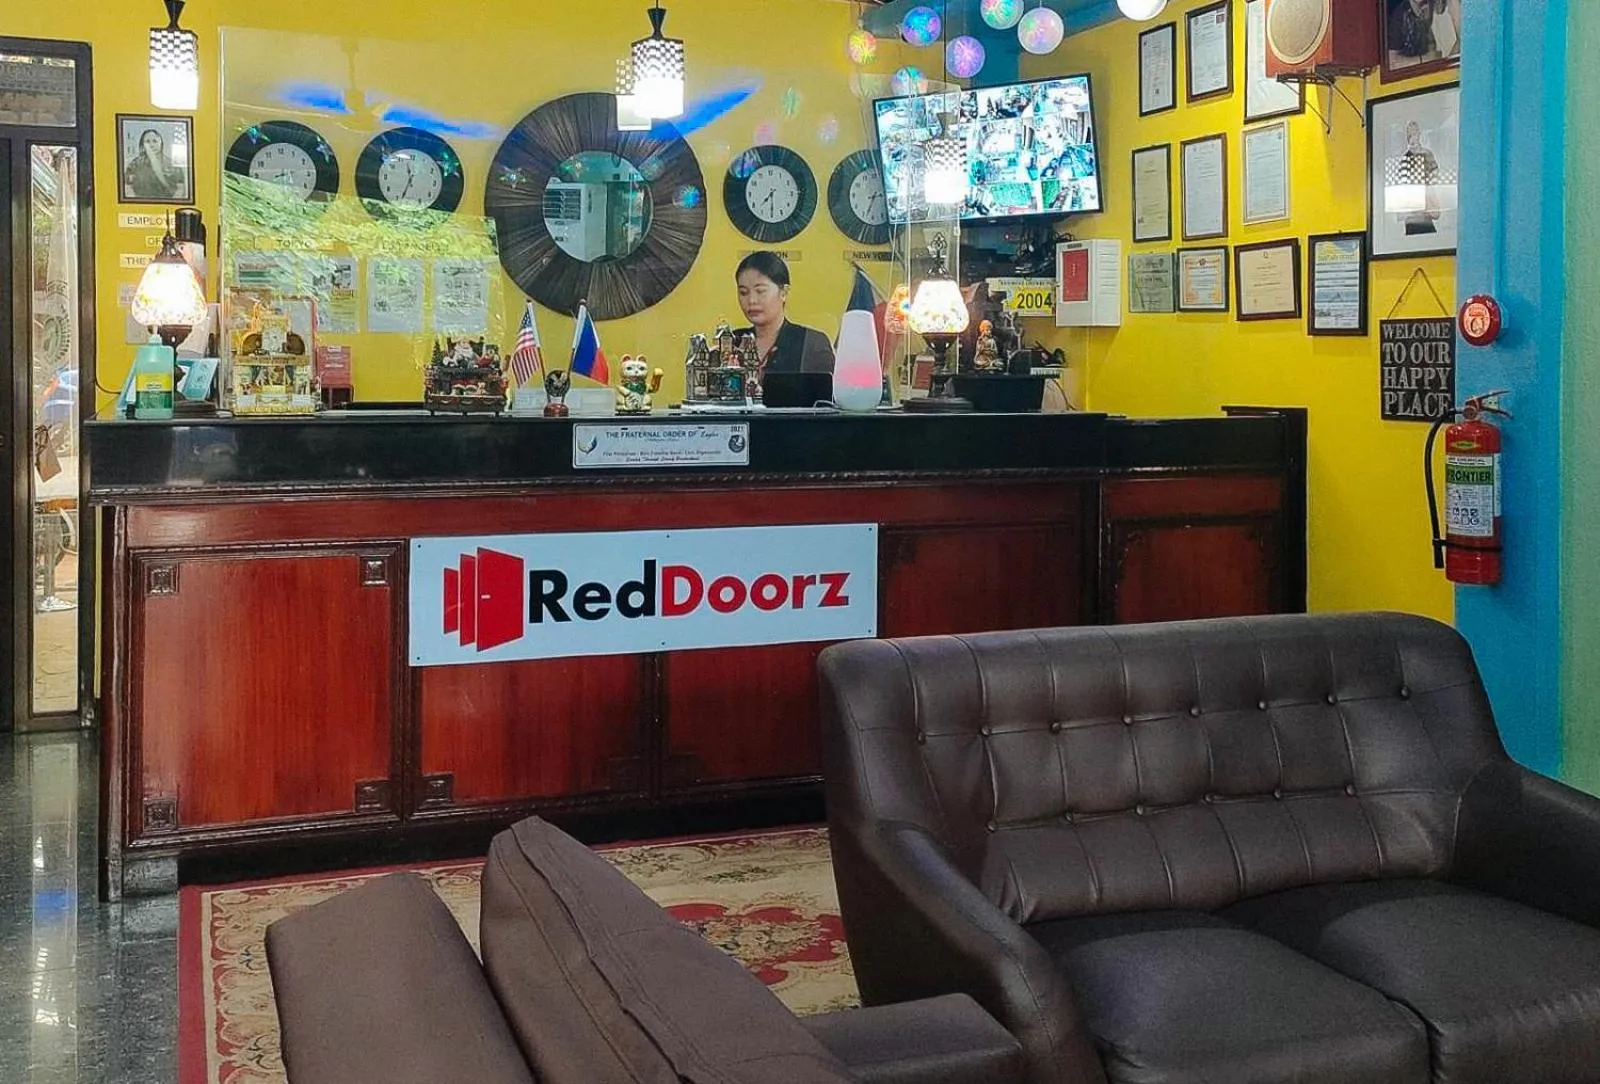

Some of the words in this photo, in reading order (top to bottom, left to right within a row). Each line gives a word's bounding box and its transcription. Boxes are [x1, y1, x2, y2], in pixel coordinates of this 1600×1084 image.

[1017, 292, 1053, 309] 2004
[1382, 322, 1451, 339] WELCOME
[1382, 341, 1406, 364] TO
[1410, 341, 1451, 364] OUR
[1383, 366, 1451, 389] HAPPY
[606, 431, 619, 439] THE
[621, 431, 659, 439] FRATERNAL
[663, 430, 686, 438] ORDER
[528, 558, 851, 625] RedDoorz
